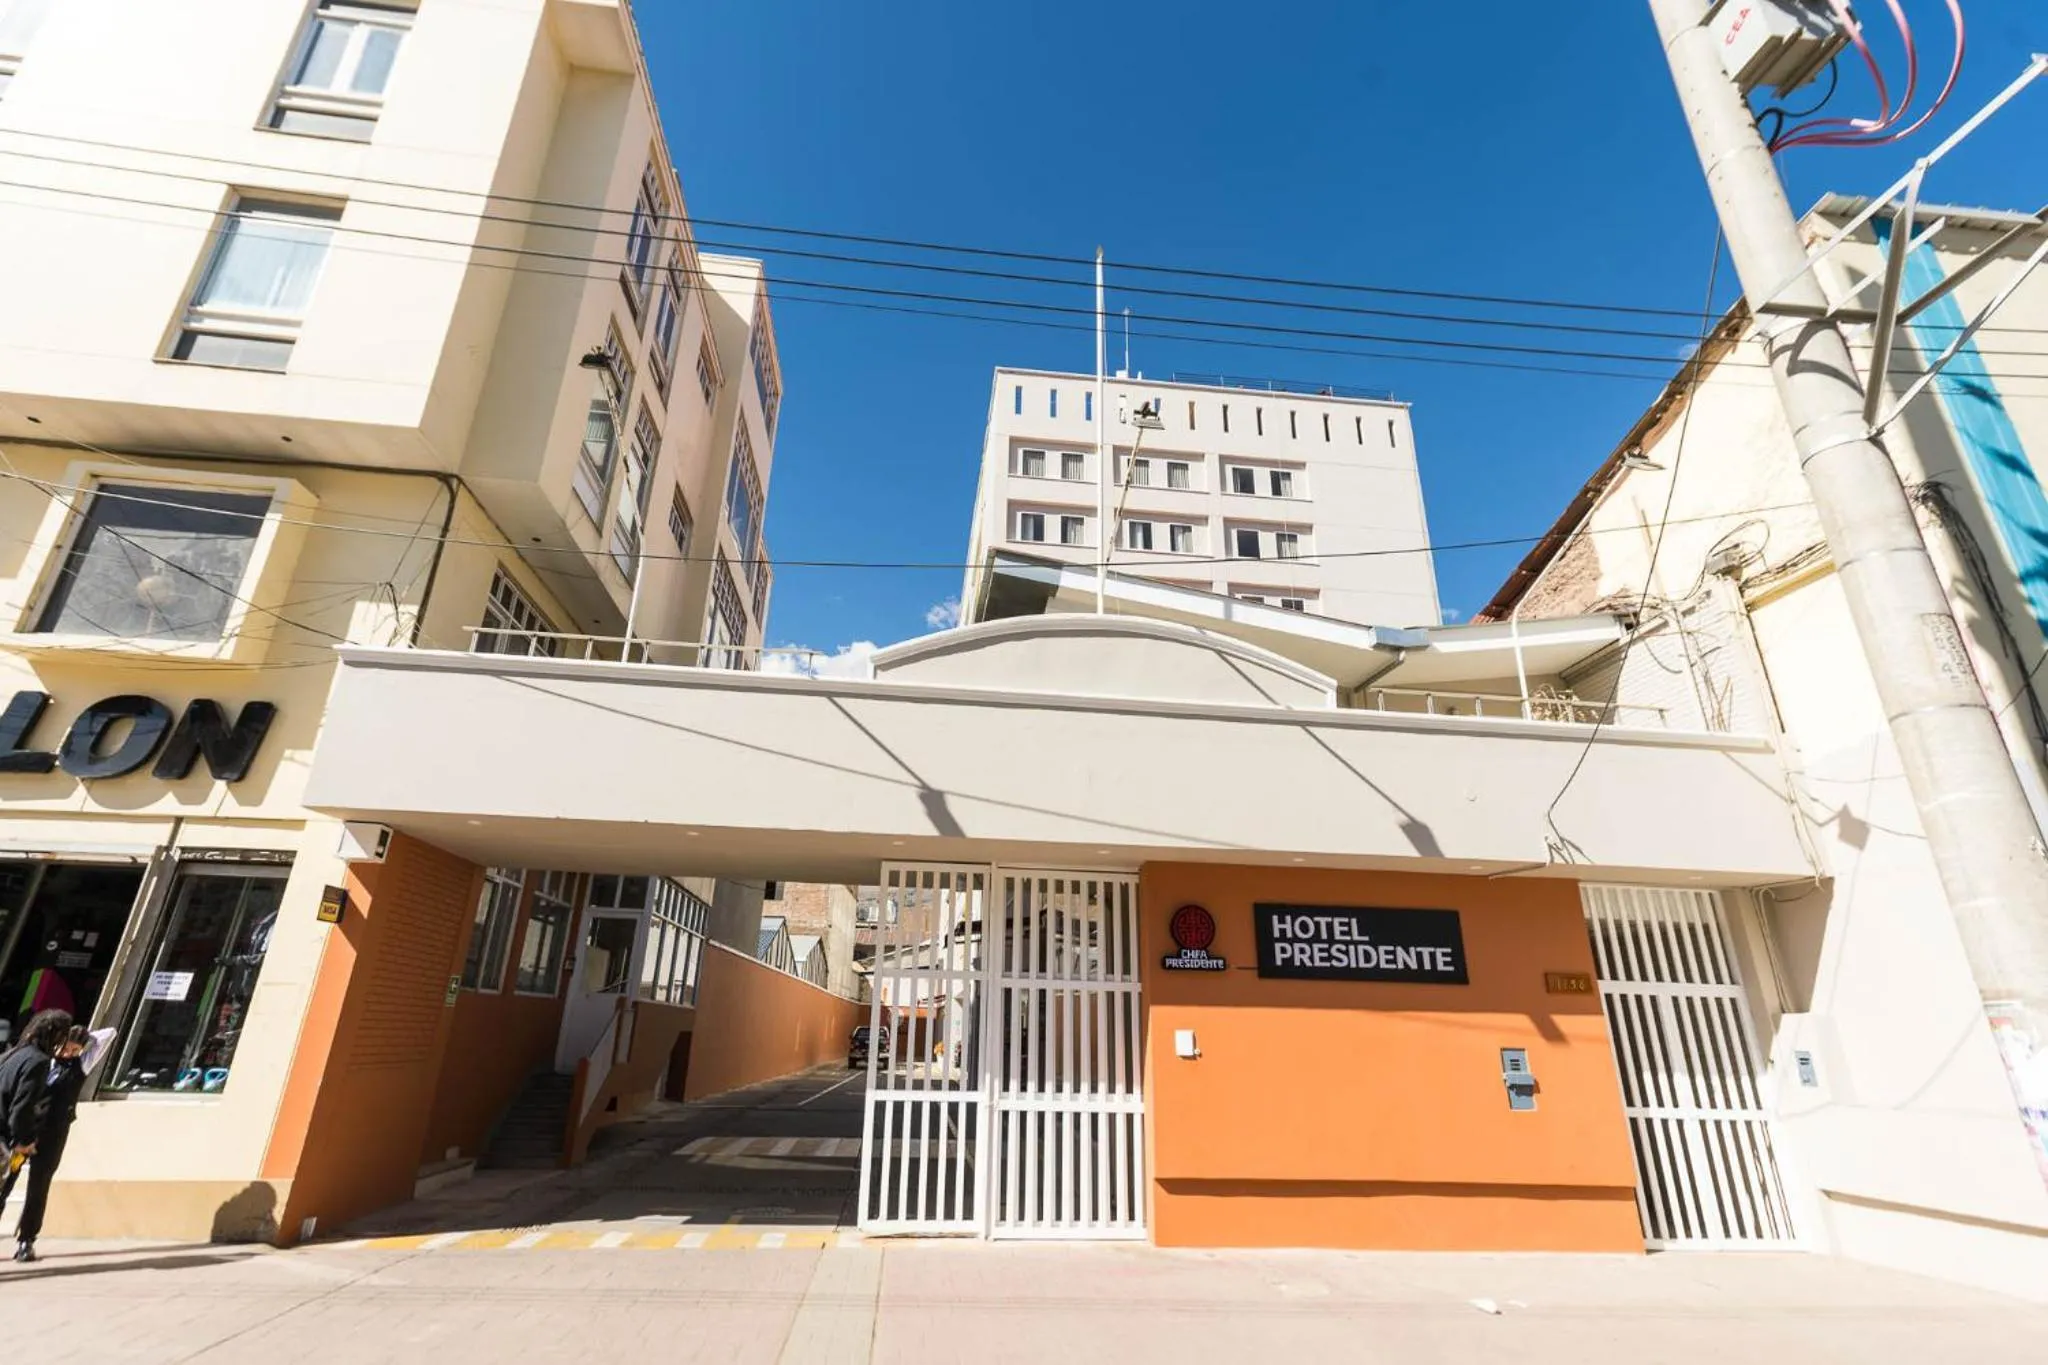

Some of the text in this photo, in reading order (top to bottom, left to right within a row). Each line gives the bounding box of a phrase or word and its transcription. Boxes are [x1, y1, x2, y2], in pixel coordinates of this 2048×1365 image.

[0, 690, 277, 782] LON
[1272, 914, 1370, 942] HOTEL
[1165, 957, 1225, 969] PRESIDENTE
[1274, 942, 1455, 972] PRESIDENTE
